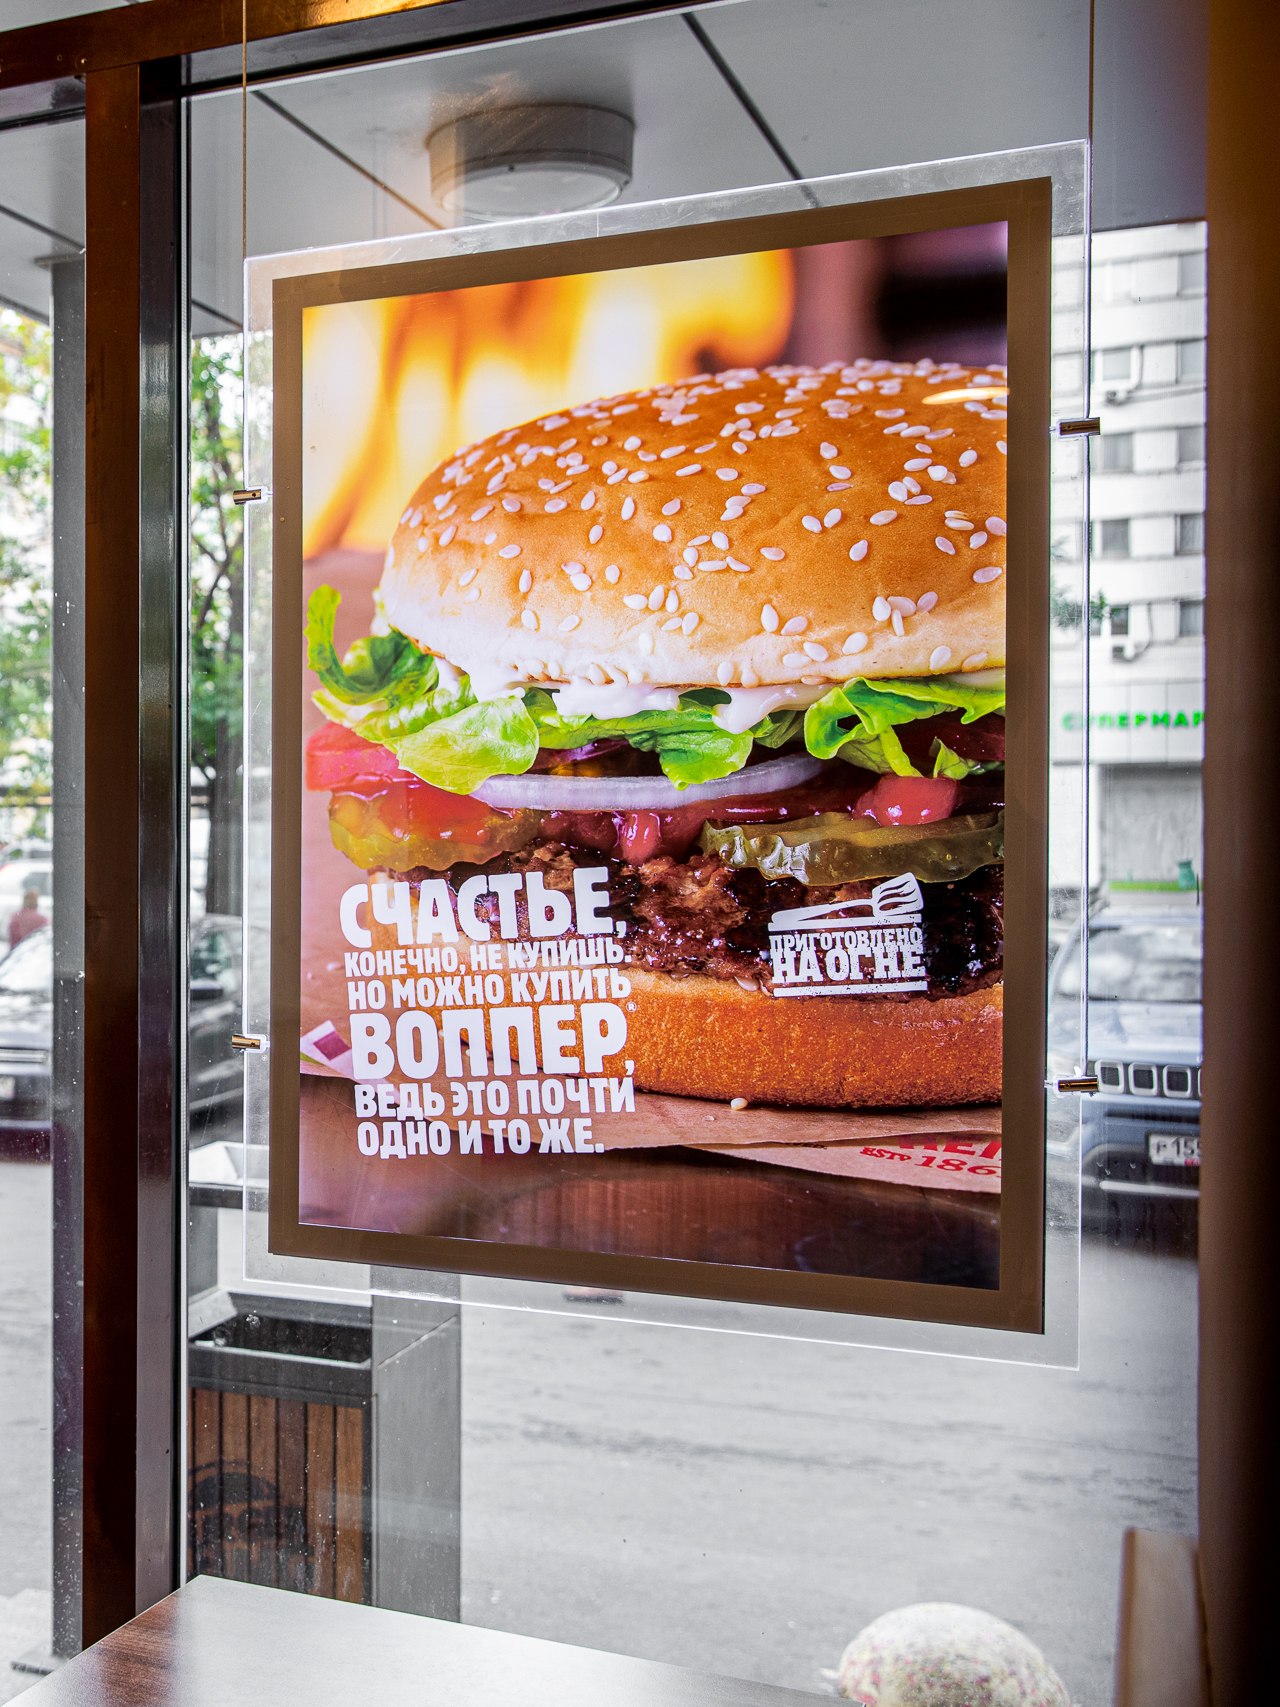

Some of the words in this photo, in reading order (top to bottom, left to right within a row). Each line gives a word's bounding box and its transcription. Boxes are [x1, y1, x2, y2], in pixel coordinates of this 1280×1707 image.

[339, 866, 627, 948] СЧАСТЬЕ,
[344, 947, 466, 977] КОНЕЧНО,
[470, 945, 503, 971] НЕ
[507, 937, 632, 969] КУПИШЬ.
[769, 927, 924, 952] ПРИГОТОВЛЕНО
[772, 950, 824, 984] НА
[824, 946, 927, 982] ОГНЕ
[347, 980, 387, 1011] НО
[392, 974, 506, 1008] МОЖНО
[510, 968, 632, 1003] КУПИТЬ
[354, 1080, 446, 1121] ВЕДЬ
[450, 1080, 509, 1116] ЭТО
[516, 1077, 636, 1115] ПОЧТИ
[357, 1120, 452, 1159] ОДНО
[458, 1119, 484, 1154] И
[488, 1118, 532, 1154] ТО
[538, 1117, 605, 1153] ЖЕ.
[915, 1155, 1002, 1178] 186
